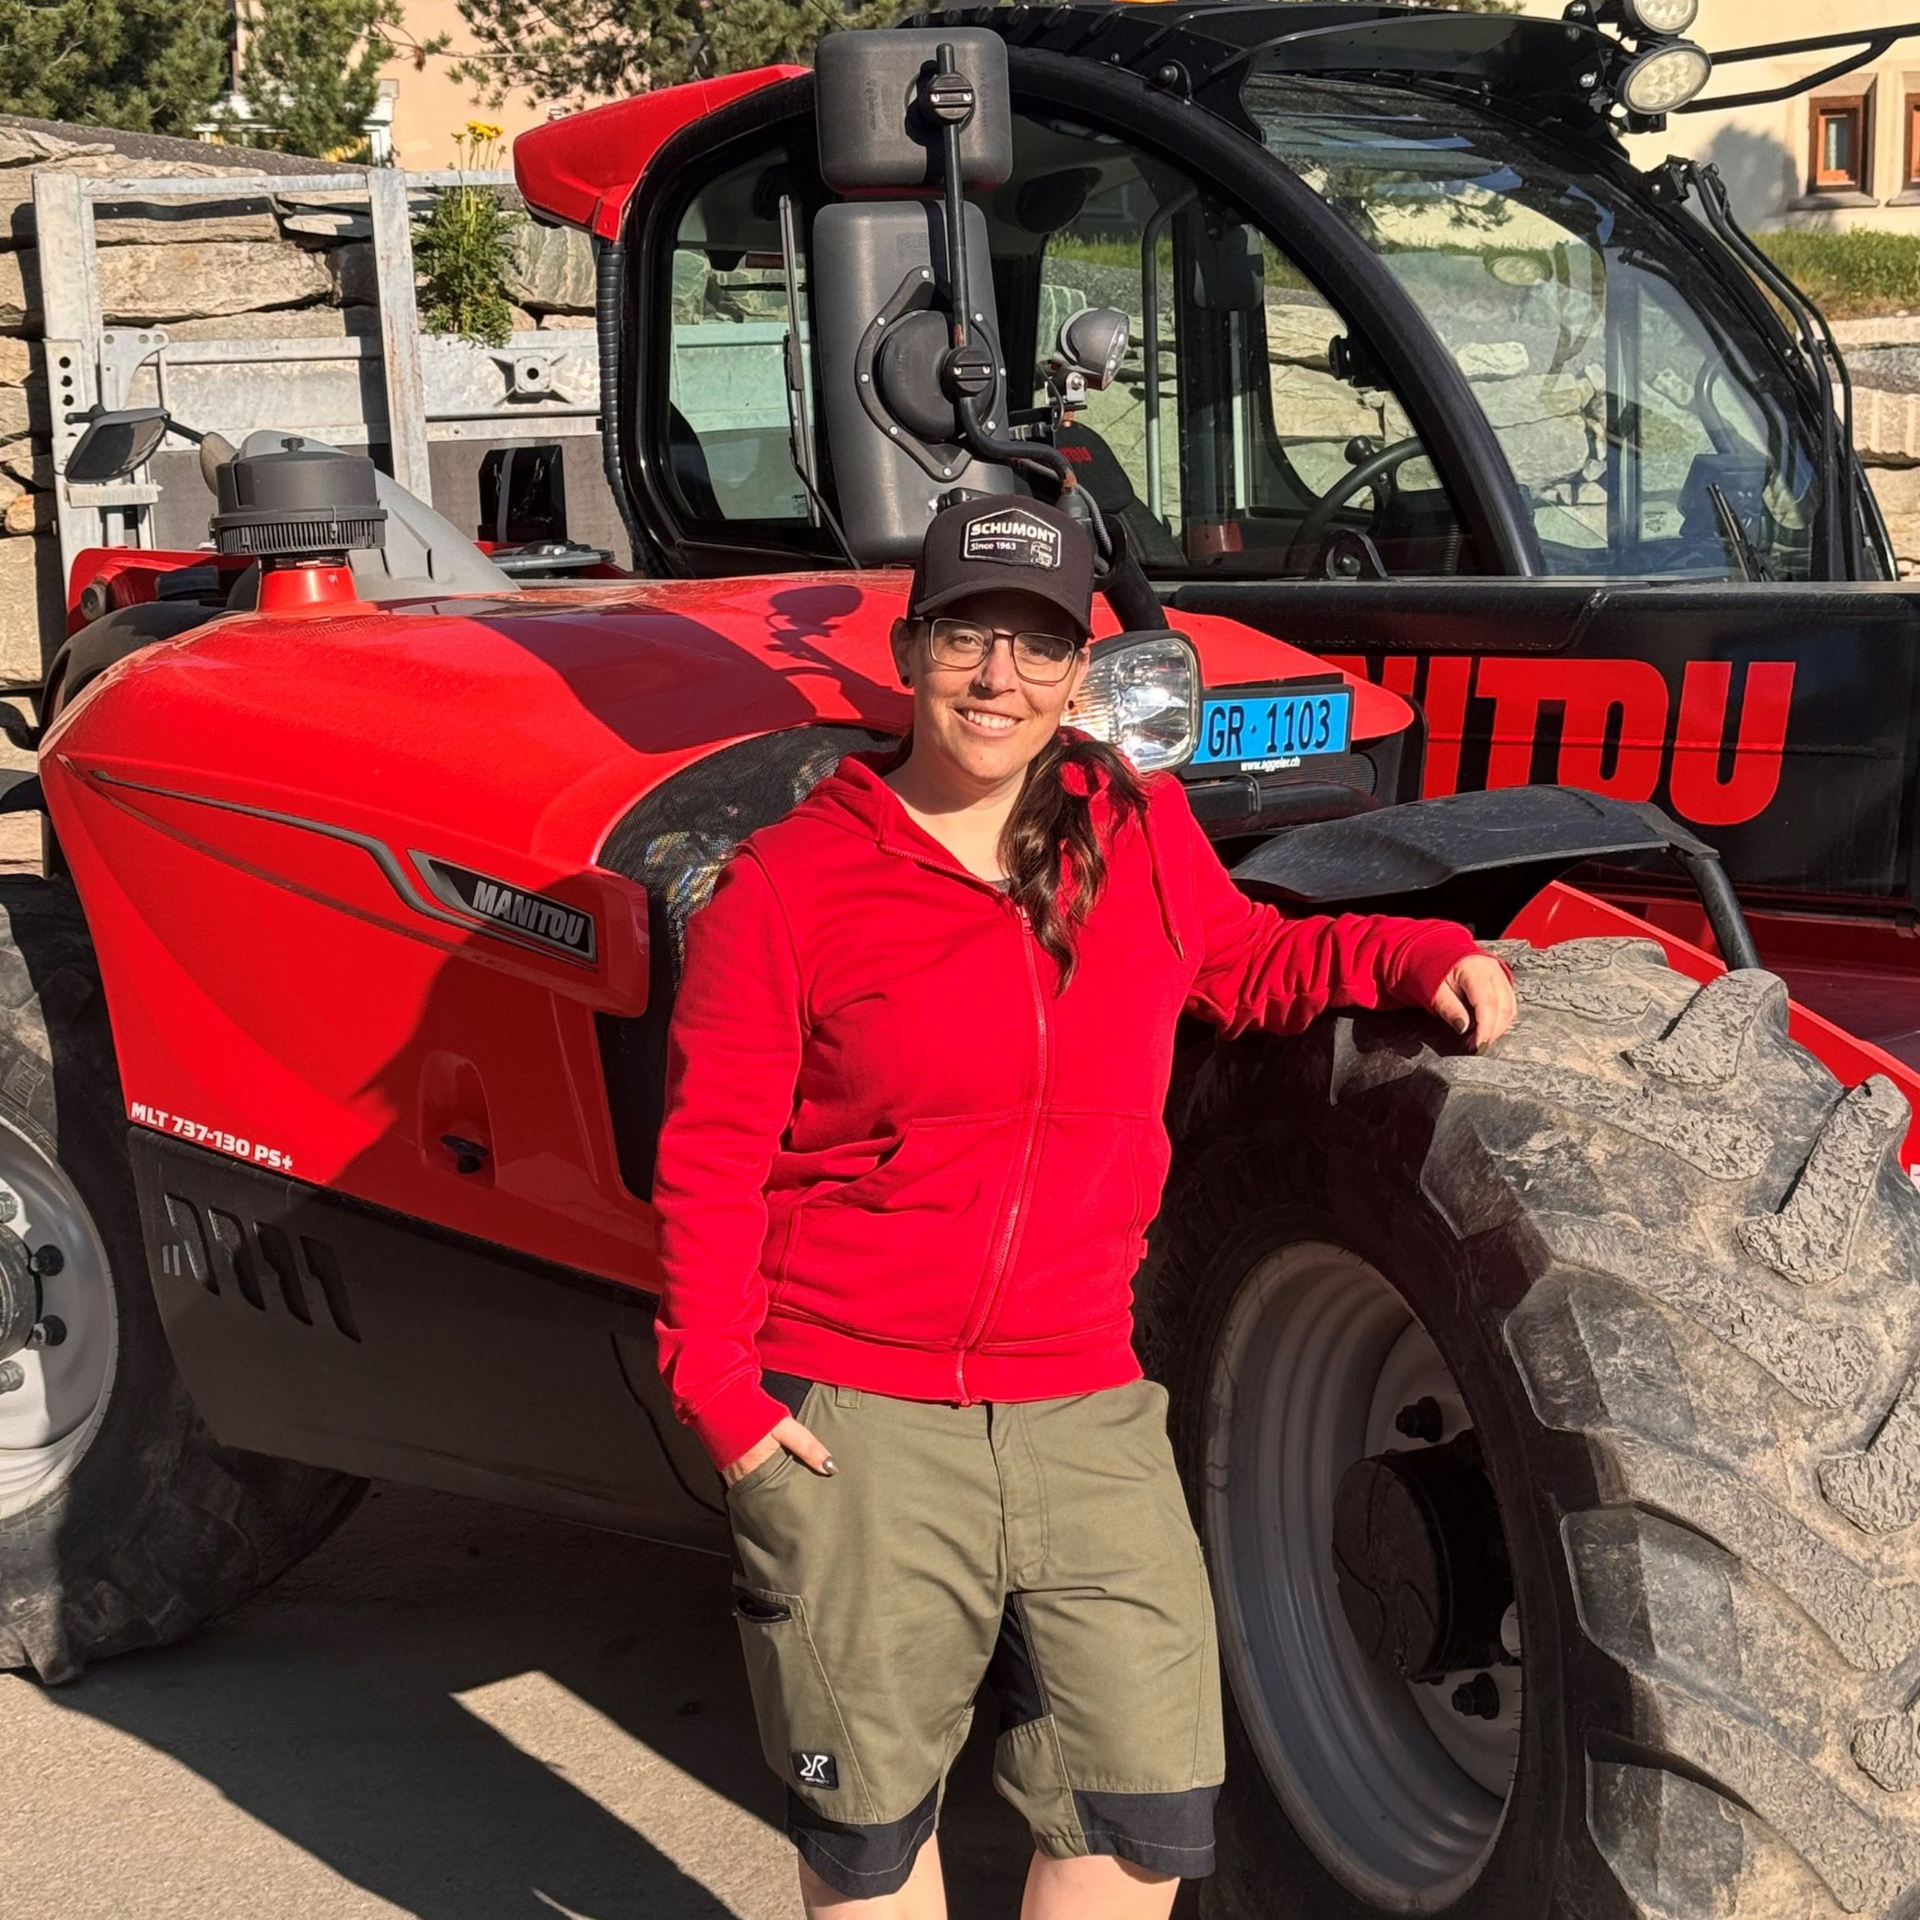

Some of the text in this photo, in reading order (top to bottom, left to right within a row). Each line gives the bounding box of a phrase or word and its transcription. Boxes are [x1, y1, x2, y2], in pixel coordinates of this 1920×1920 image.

[970, 522, 1057, 544] SCHUMONT
[970, 542, 1016, 551] Since 1963
[1208, 699, 1331, 758] GR 1103
[472, 880, 585, 945] MANITOU
[131, 1102, 293, 1171] MLT 737-130 PS+
